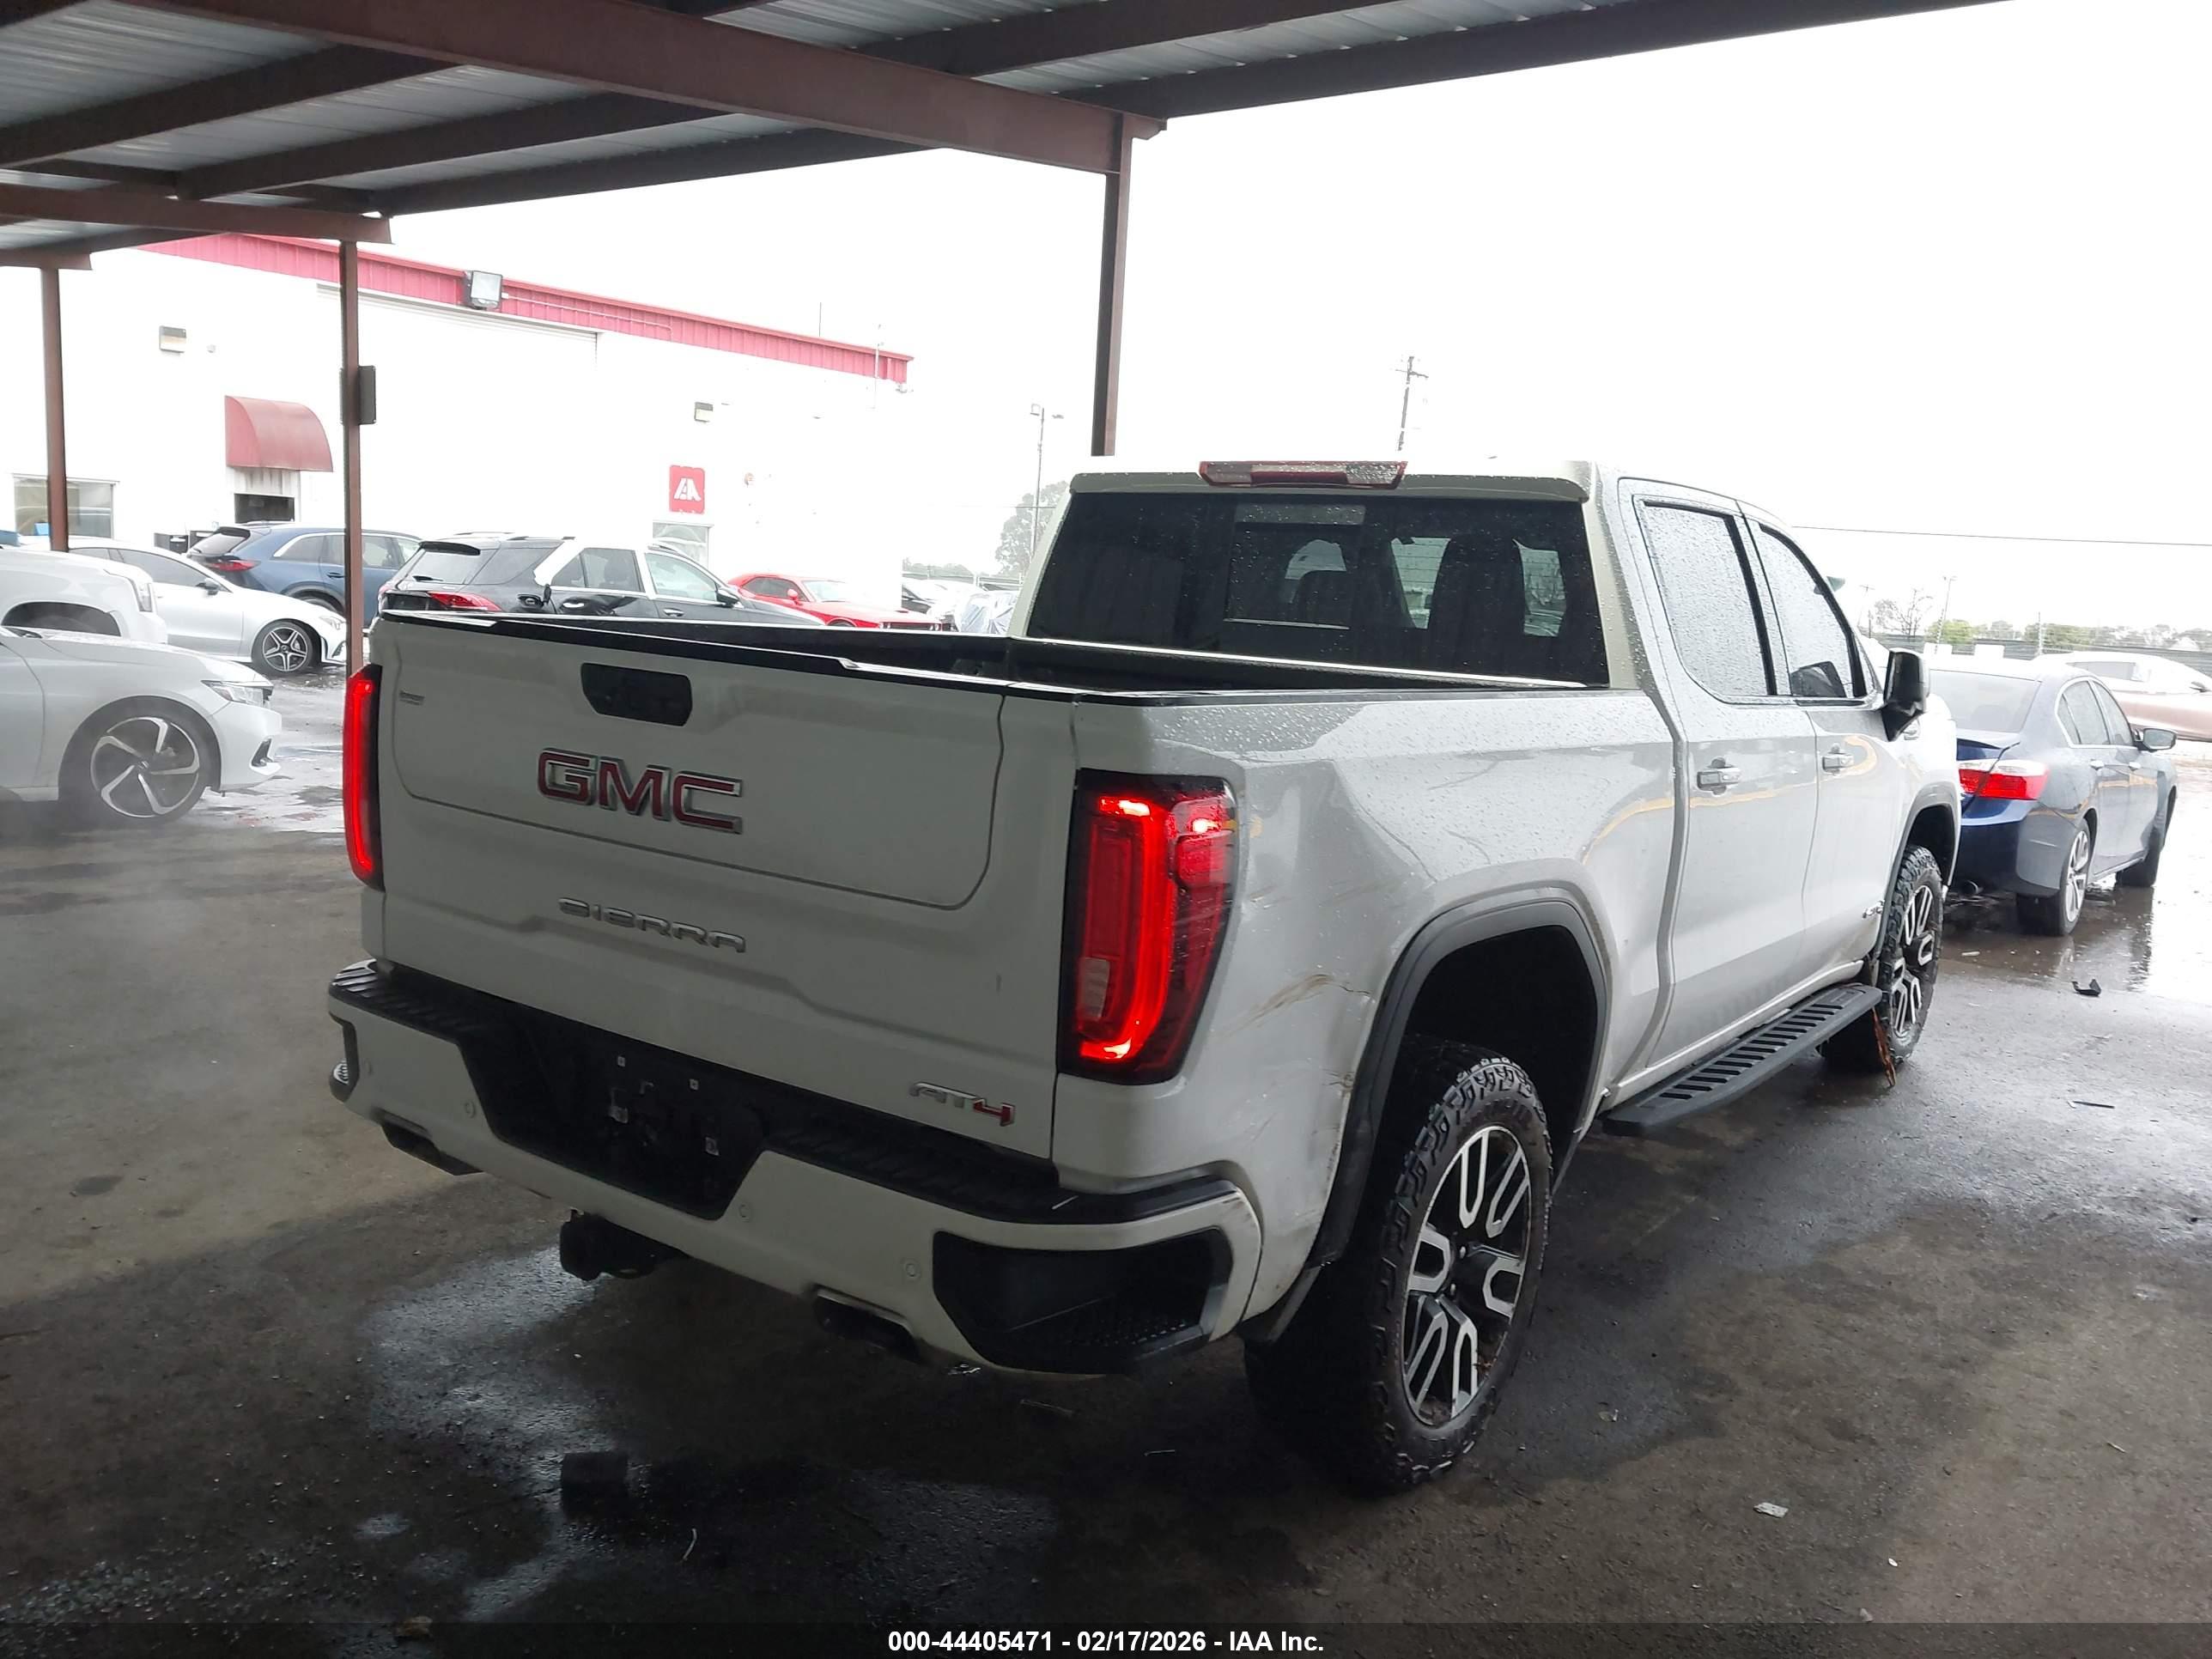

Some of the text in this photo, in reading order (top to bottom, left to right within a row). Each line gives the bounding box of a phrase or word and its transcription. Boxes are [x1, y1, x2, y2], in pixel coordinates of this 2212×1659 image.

[538, 747, 743, 835] GMC
[558, 897, 746, 953] SIERRA
[908, 1081, 1016, 1127] AT4
